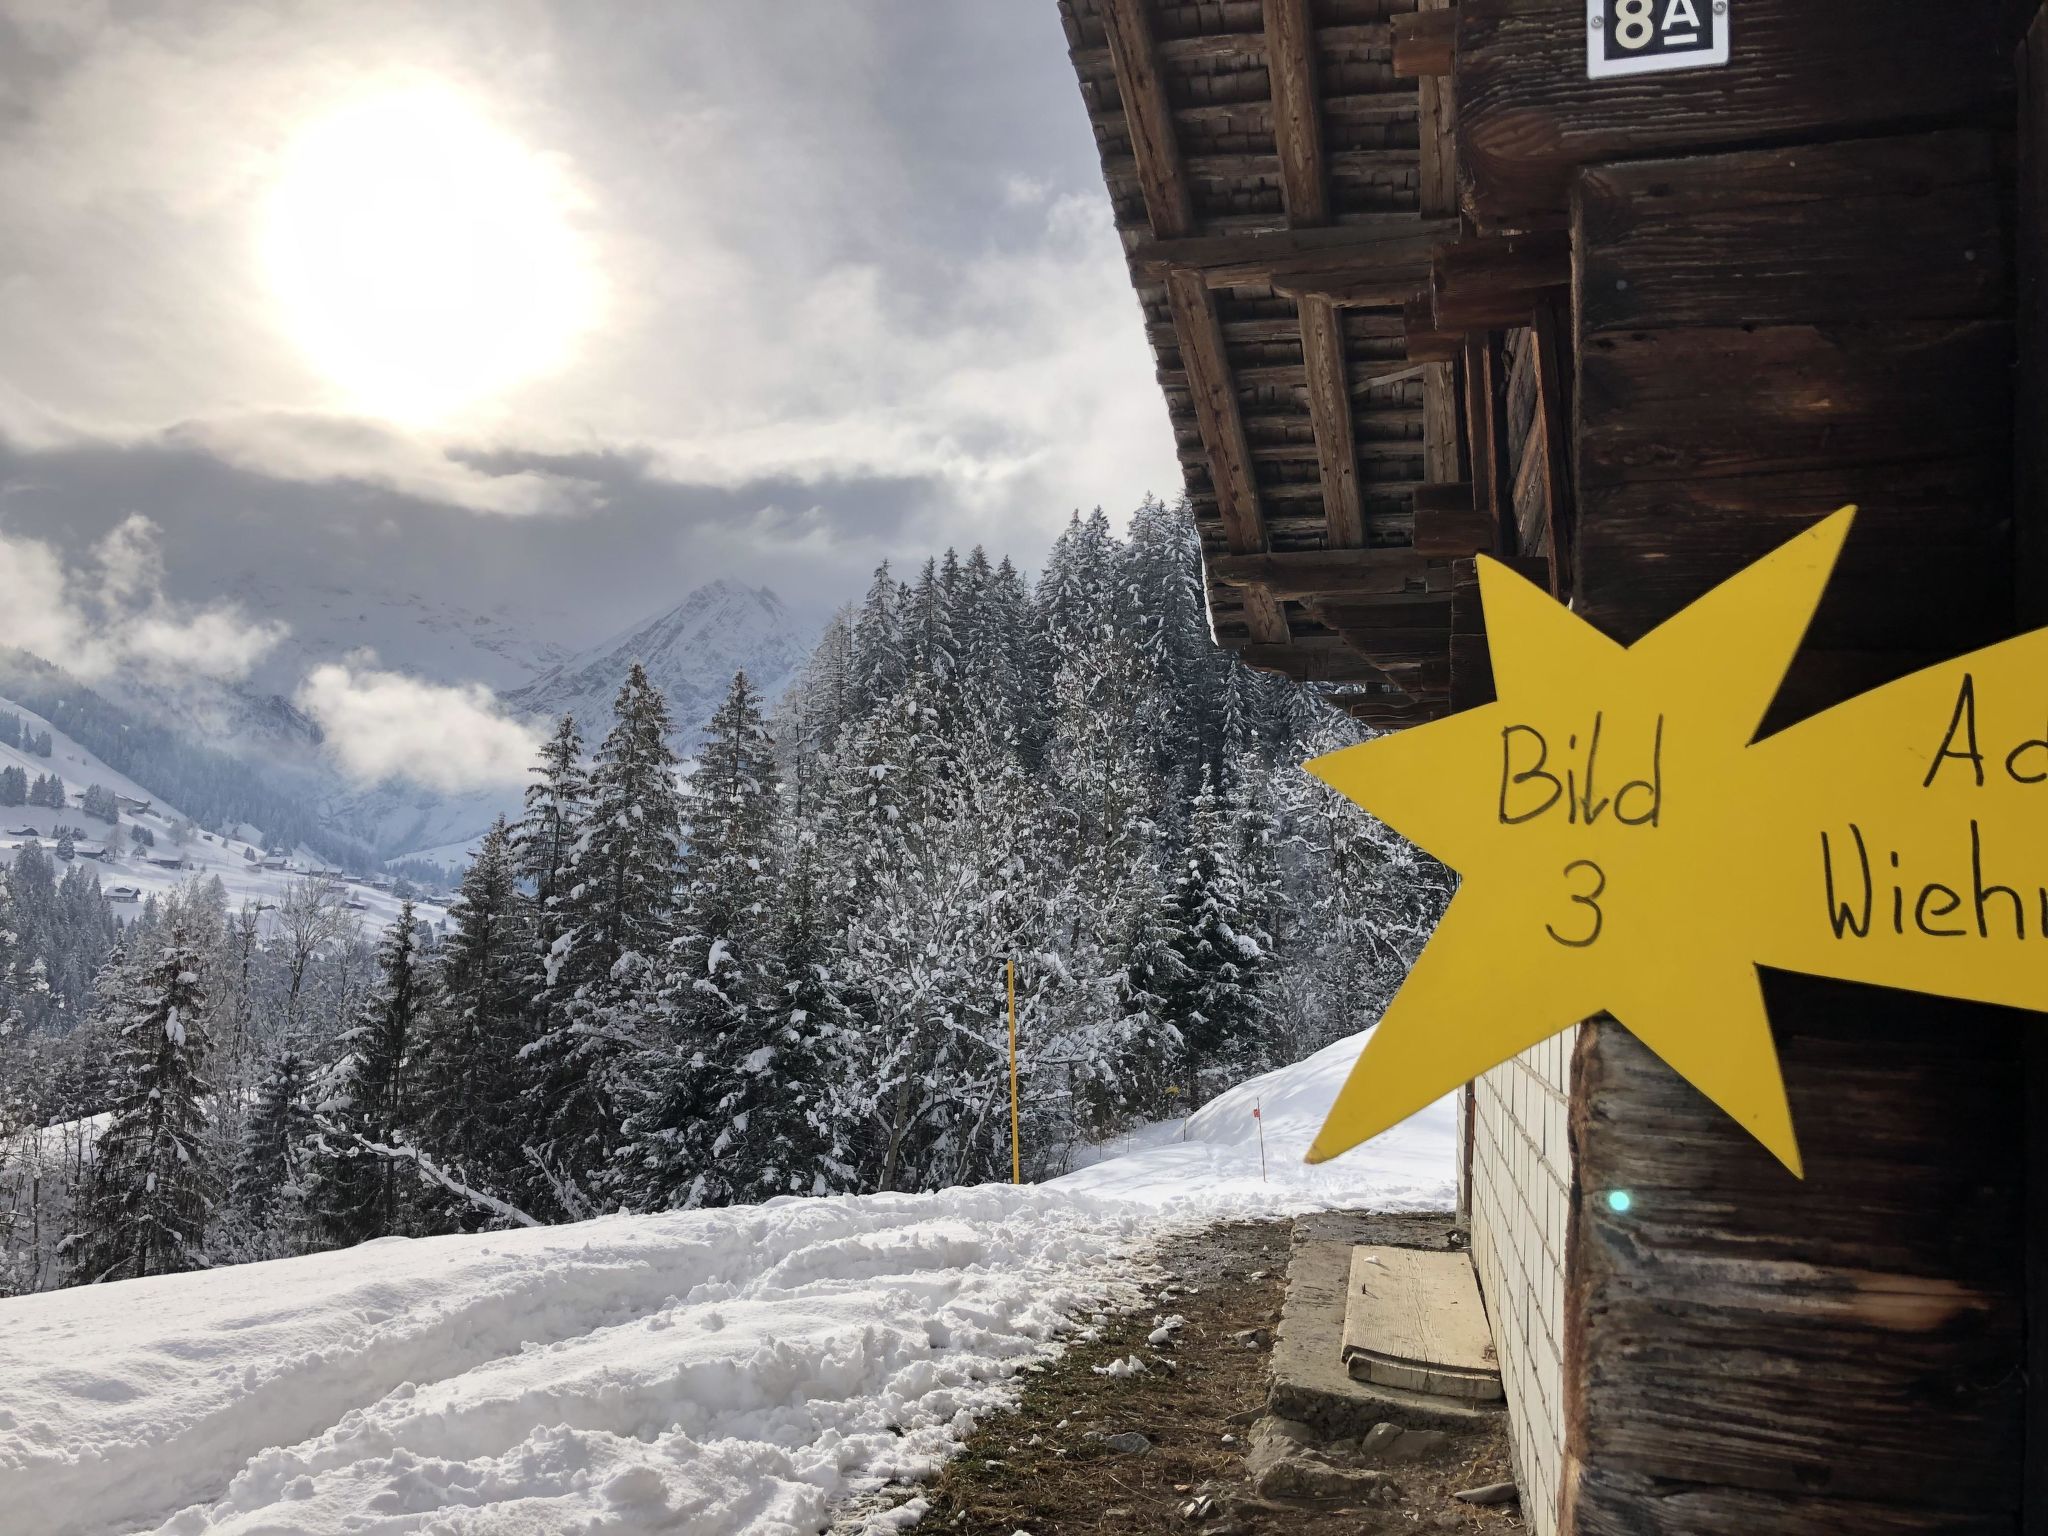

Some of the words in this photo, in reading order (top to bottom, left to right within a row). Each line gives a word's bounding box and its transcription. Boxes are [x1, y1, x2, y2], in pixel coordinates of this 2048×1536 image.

[1615, 0, 1700, 49] 8A
[1498, 710, 1664, 828] Bild
[1545, 859, 1606, 948] 3
